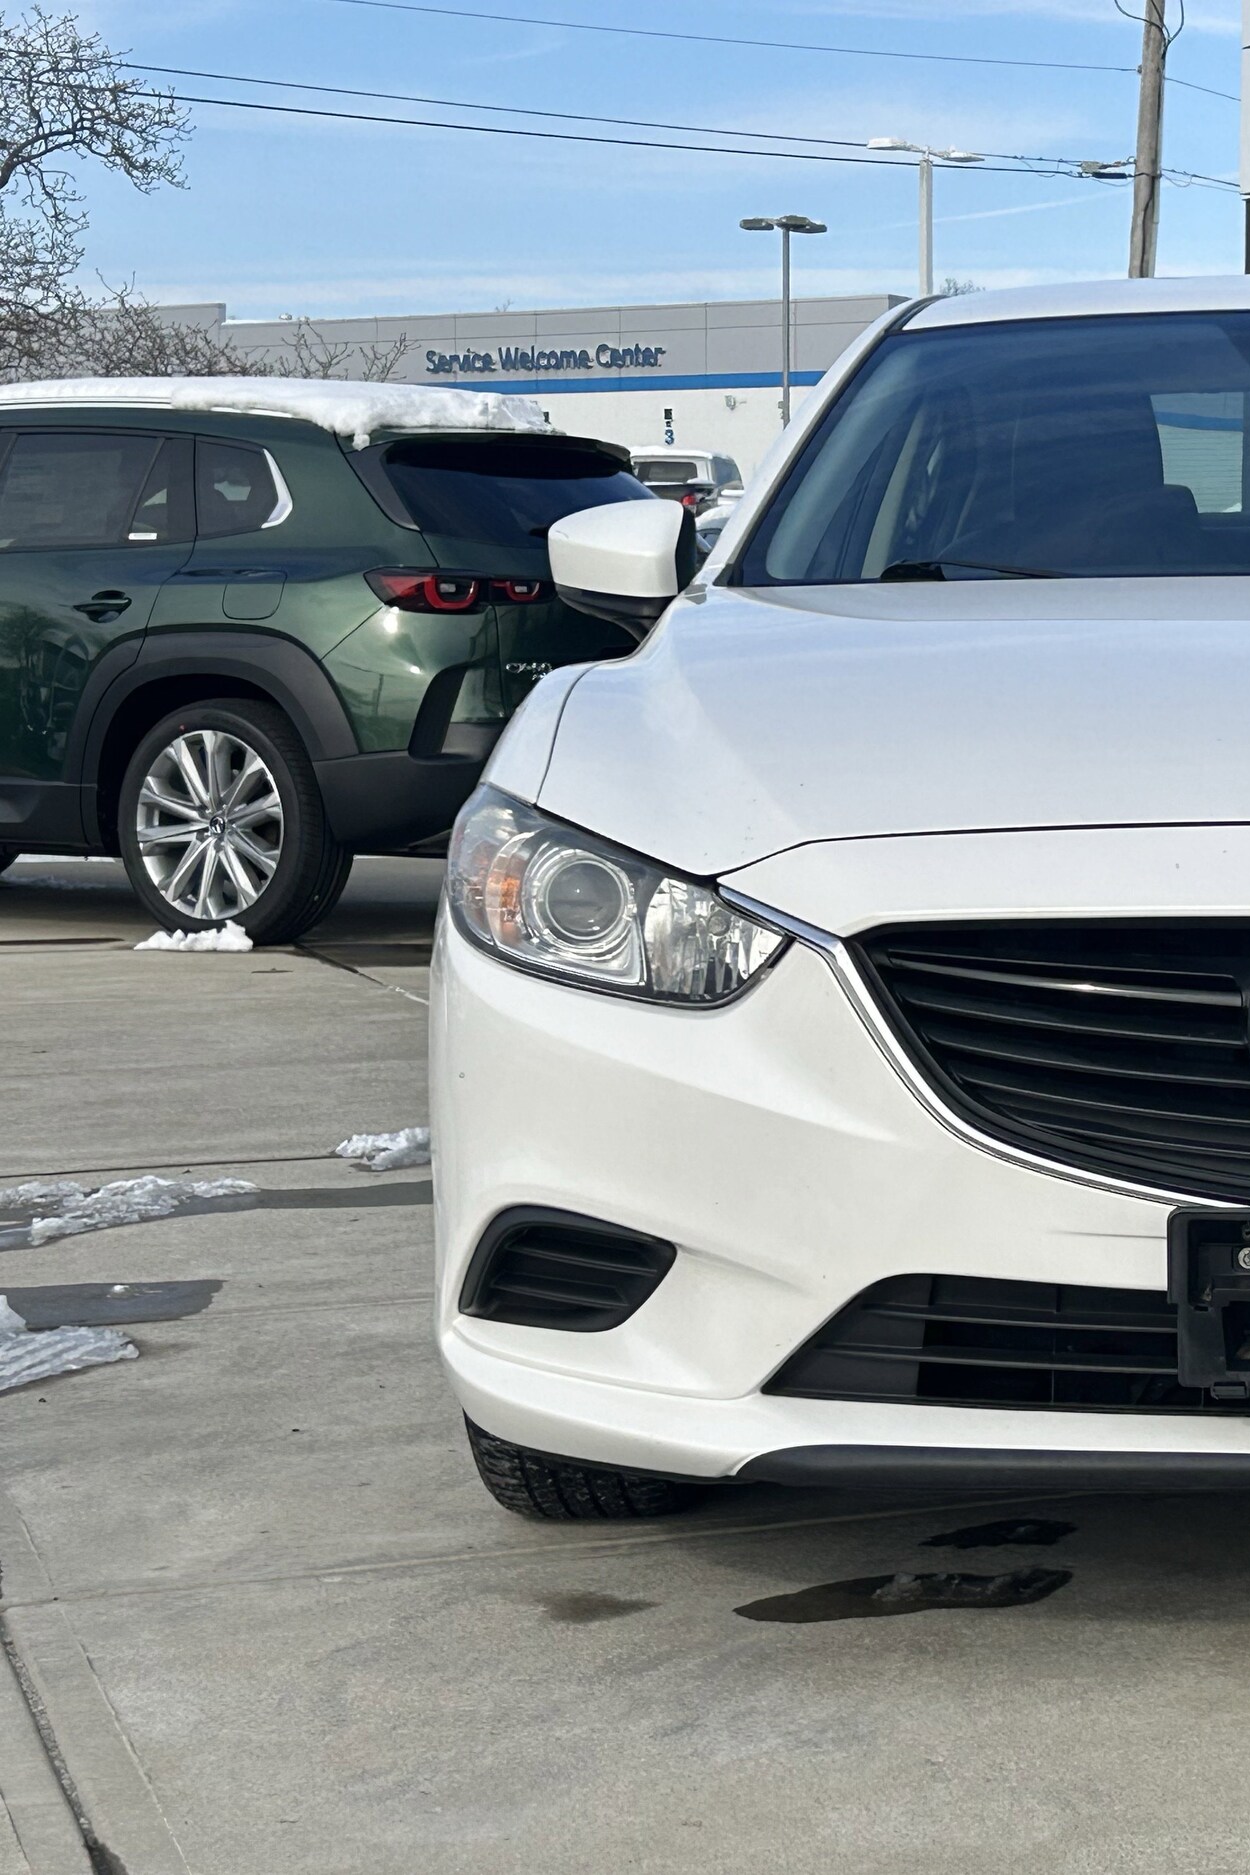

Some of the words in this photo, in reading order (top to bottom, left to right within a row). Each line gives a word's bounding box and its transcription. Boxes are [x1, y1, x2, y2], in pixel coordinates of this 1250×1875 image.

[425, 348, 497, 374] Service
[498, 345, 594, 372] Welcome
[596, 343, 667, 369] Center
[664, 428, 675, 445] 3
